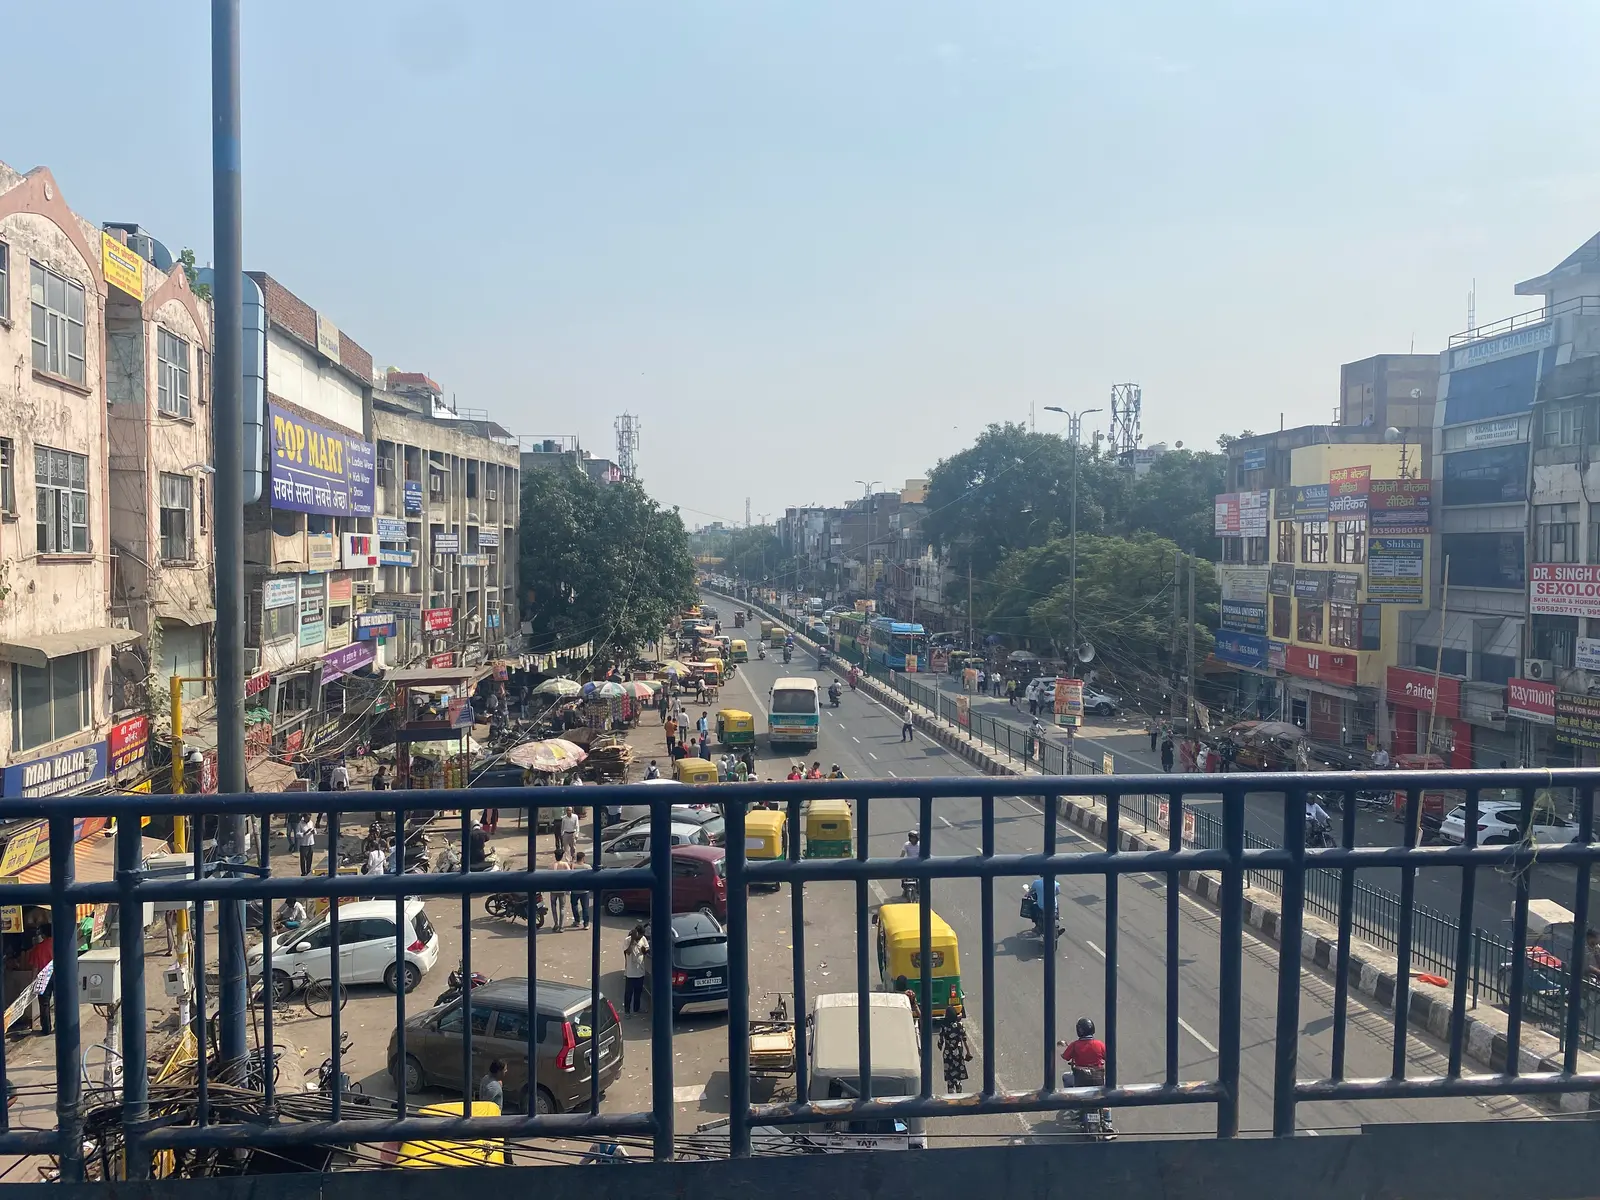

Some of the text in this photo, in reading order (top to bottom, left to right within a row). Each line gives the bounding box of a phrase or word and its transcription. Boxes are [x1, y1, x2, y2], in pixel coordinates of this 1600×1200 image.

[1502, 326, 1552, 351] CHAMBERS
[274, 415, 343, 475] TOP MART
[273, 473, 348, 509] सबसे सस्ता सबसे अच्छा
[1386, 540, 1421, 549] Shiksha
[1533, 567, 1593, 580] DR. SINGH
[1413, 683, 1435, 700] airtel
[1559, 704, 1574, 712] CASH
[25, 751, 85, 788] MAA KALKA
